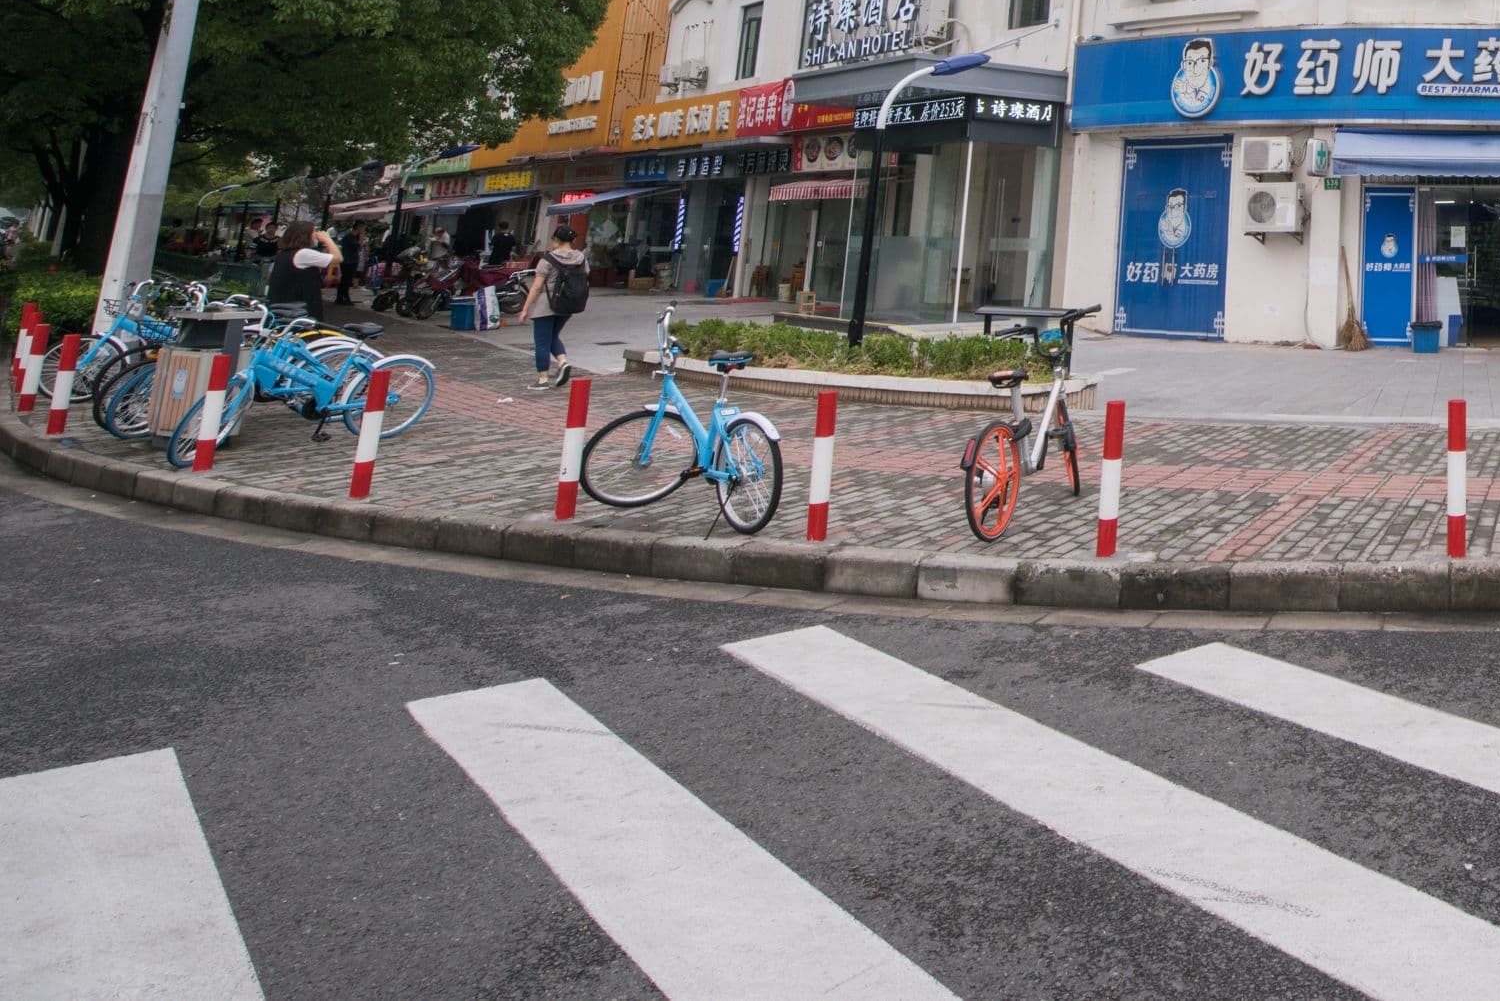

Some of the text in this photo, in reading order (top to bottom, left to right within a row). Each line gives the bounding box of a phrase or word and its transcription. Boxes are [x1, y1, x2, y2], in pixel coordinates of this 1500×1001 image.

[804, 30, 910, 67] SHI CAN HOTEL
[1420, 84, 1447, 94] BEST
